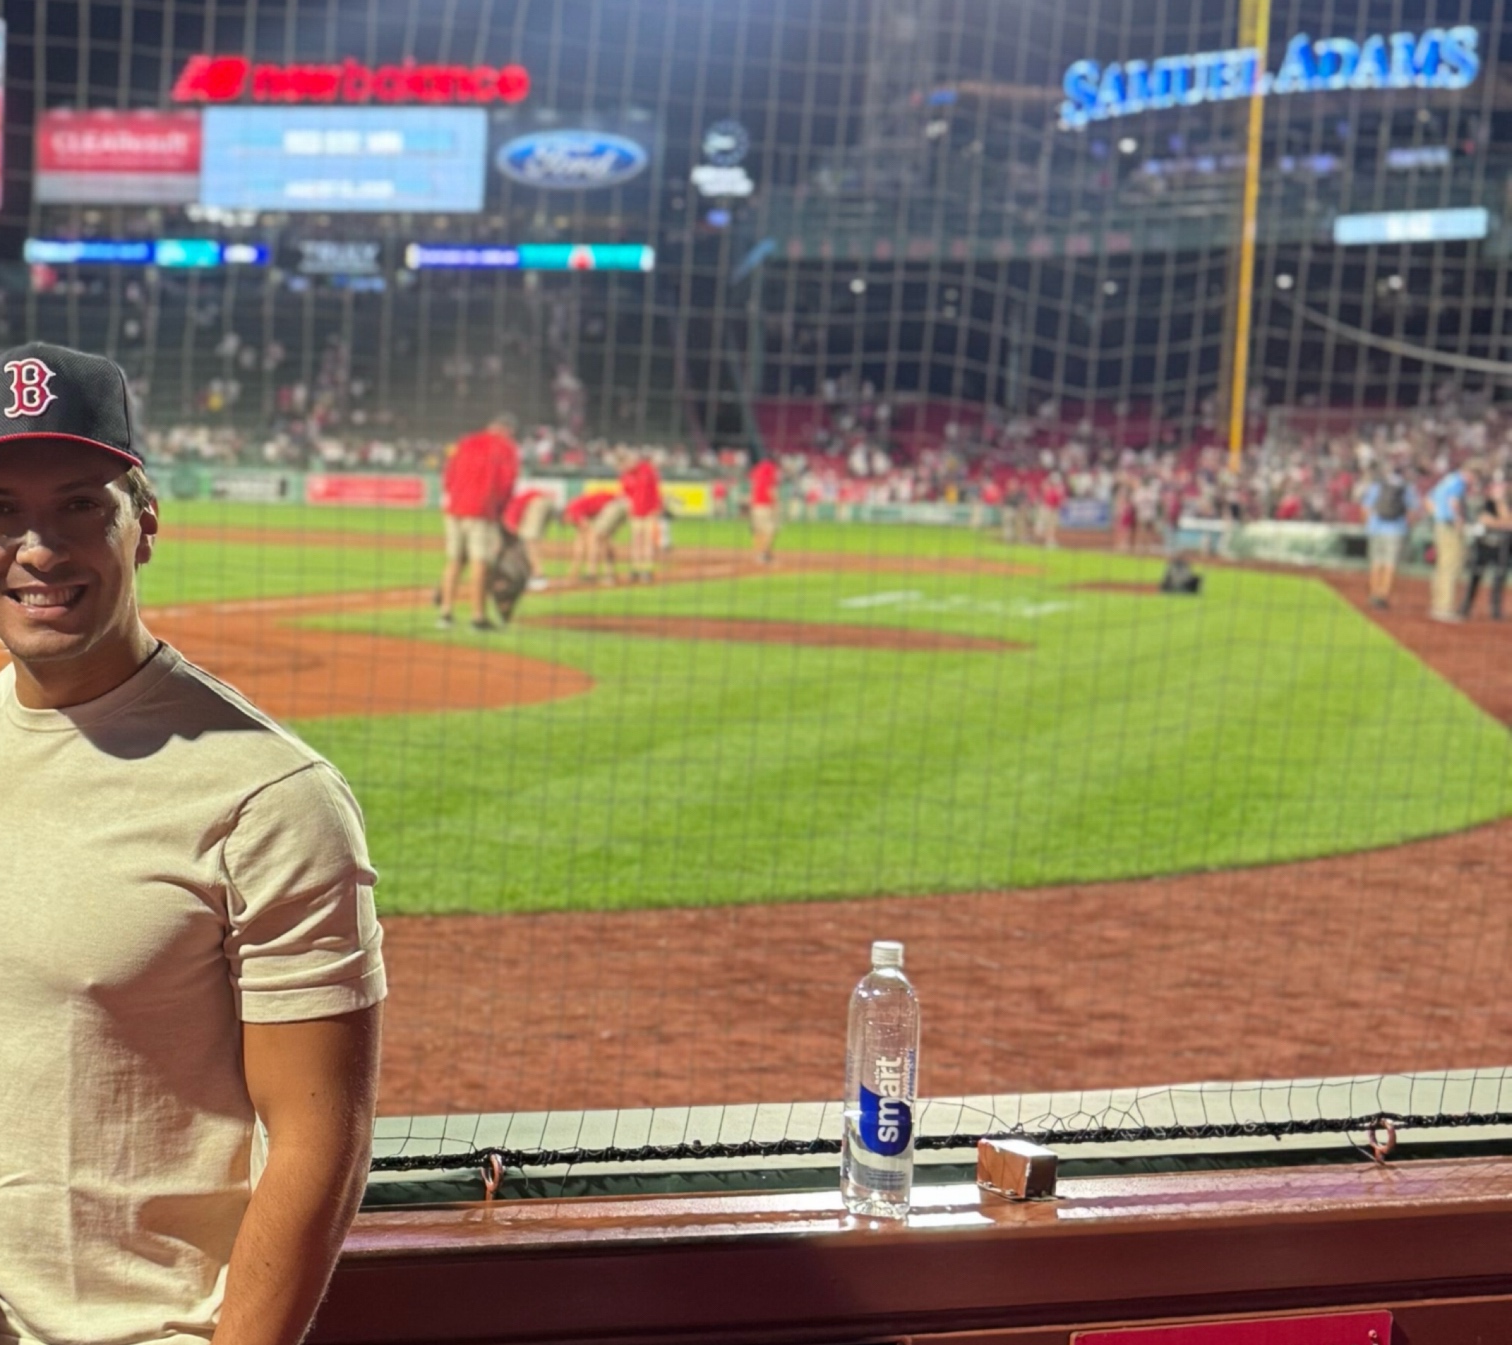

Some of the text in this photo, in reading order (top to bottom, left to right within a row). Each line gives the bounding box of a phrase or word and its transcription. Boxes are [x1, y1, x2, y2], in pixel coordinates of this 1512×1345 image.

[1061, 25, 1481, 130] SAMUEL ADAMS
[4, 358, 59, 419] B
[877, 1056, 901, 1143] smart
